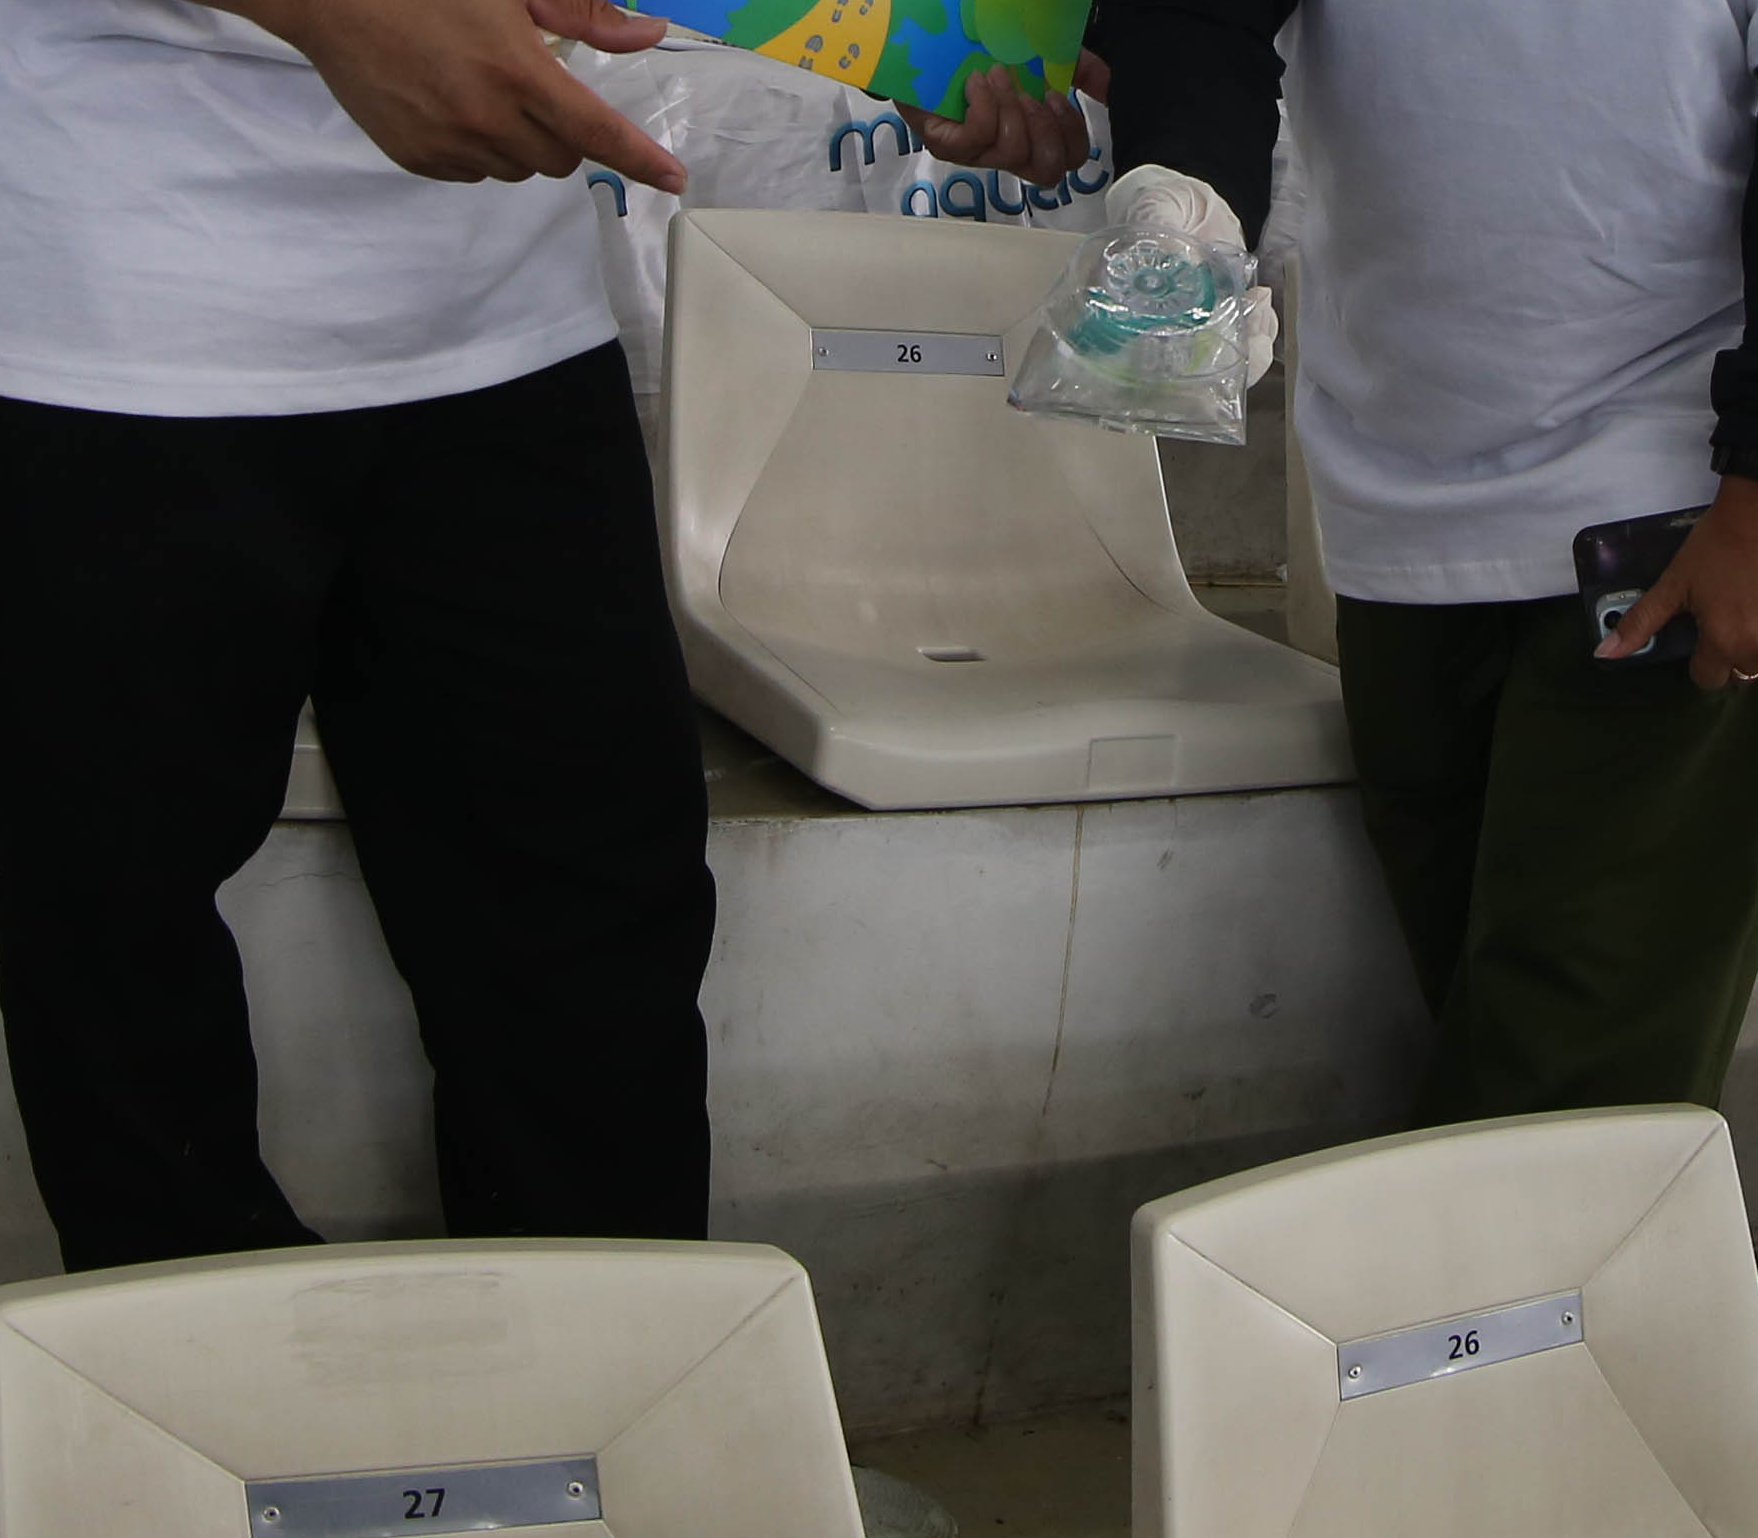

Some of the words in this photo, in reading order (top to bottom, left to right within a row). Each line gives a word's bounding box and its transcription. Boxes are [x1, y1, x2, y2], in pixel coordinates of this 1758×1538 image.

[896, 343, 923, 364] 26
[1447, 1329, 1481, 1361] 26
[402, 1487, 447, 1521] 27
